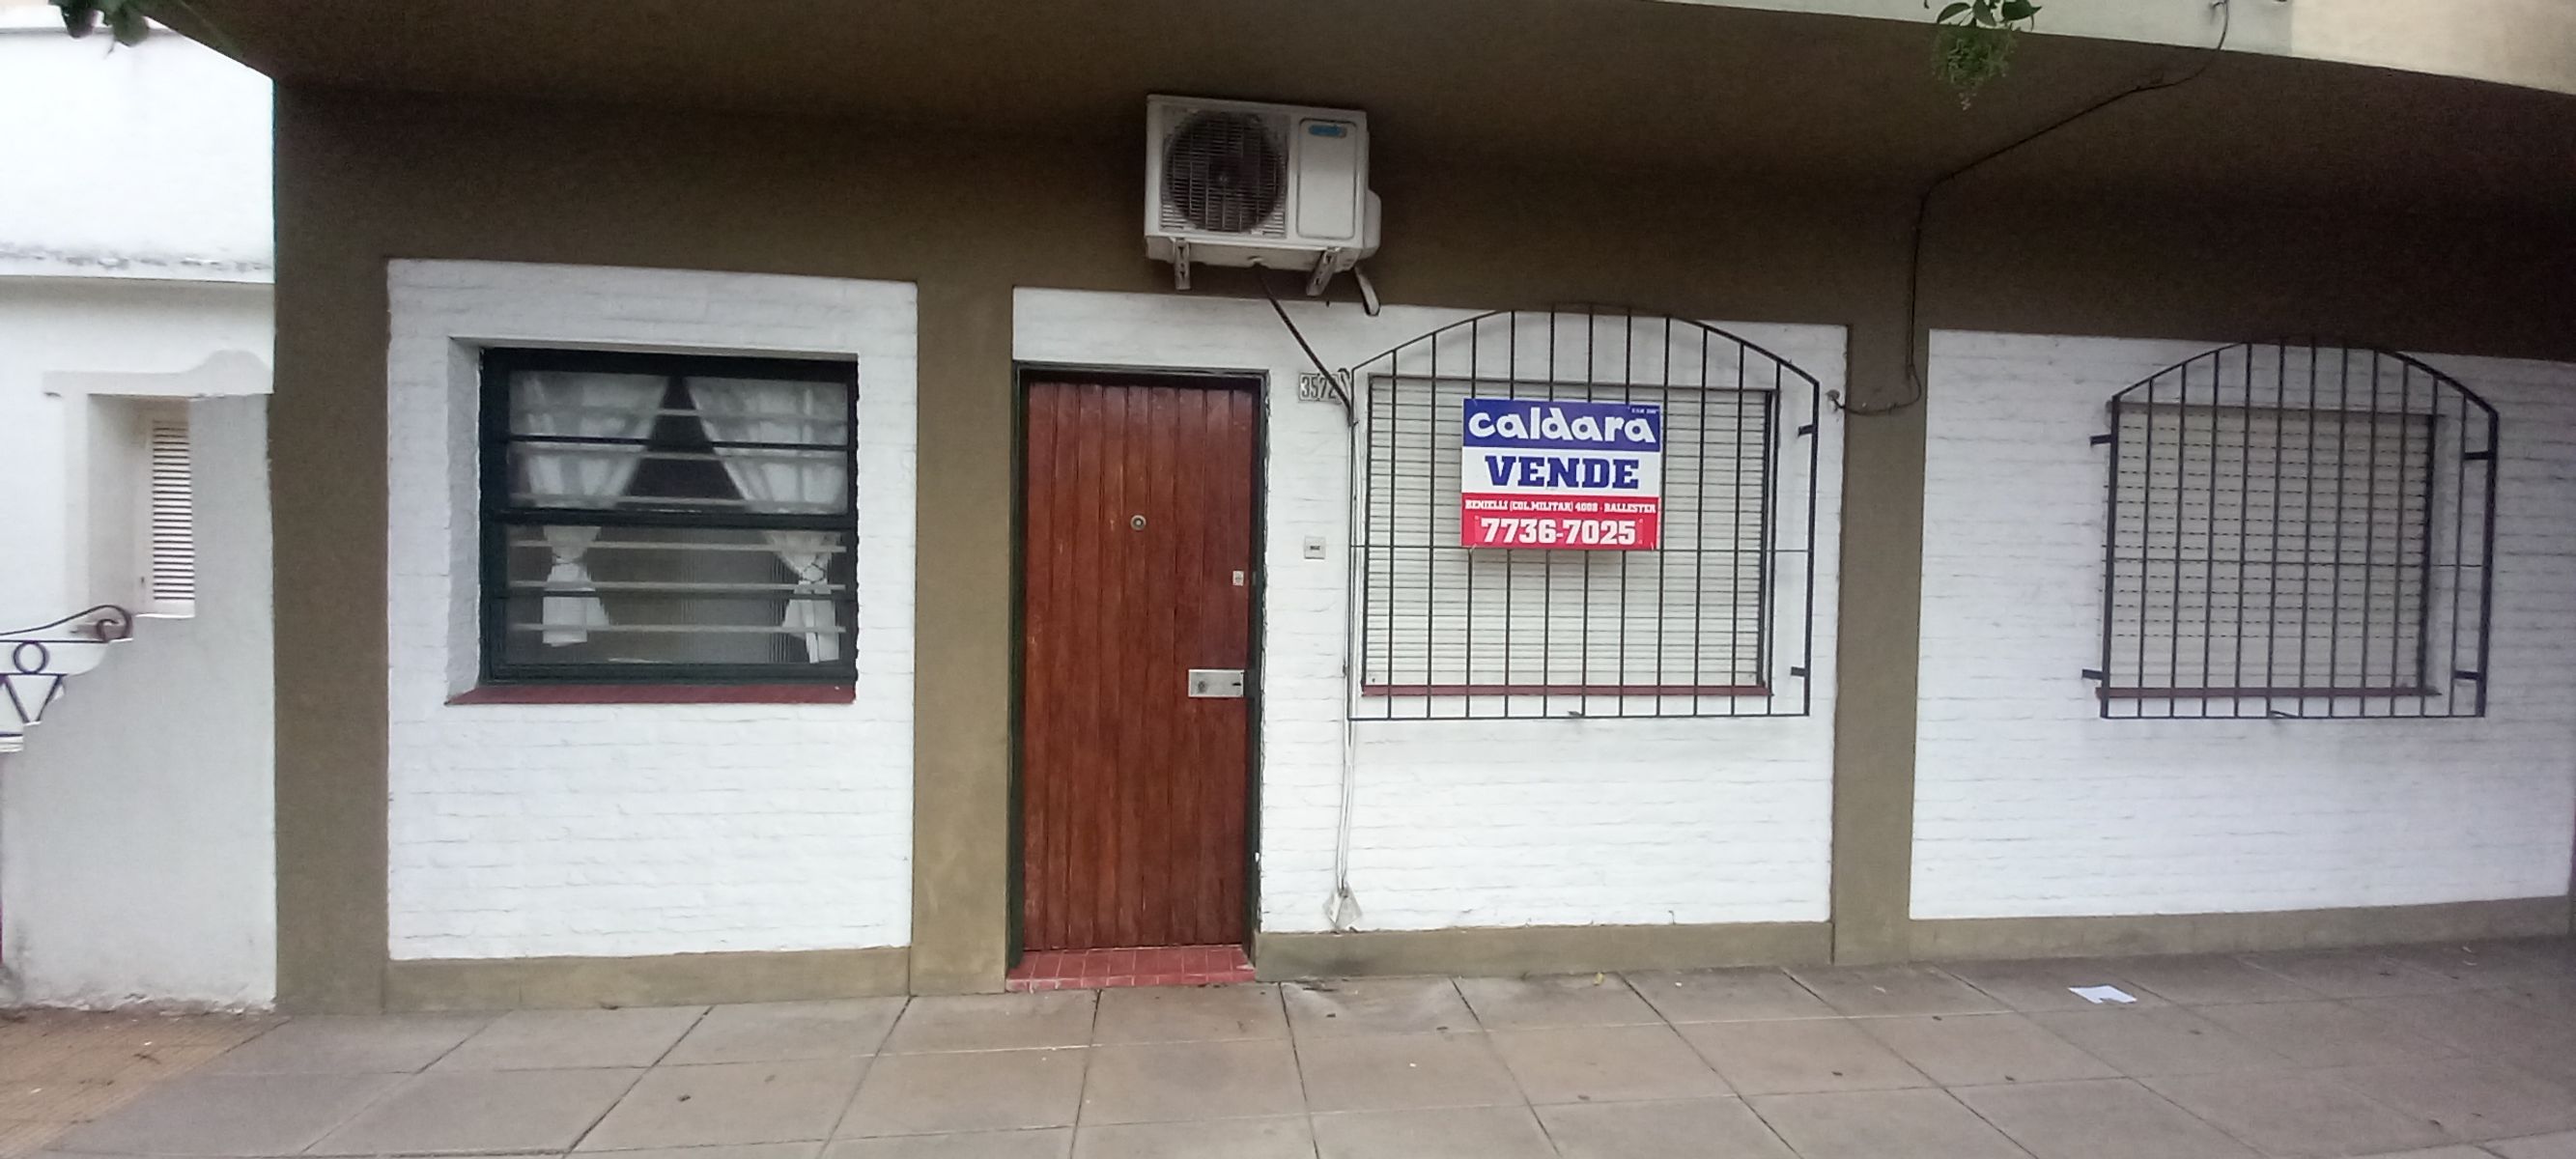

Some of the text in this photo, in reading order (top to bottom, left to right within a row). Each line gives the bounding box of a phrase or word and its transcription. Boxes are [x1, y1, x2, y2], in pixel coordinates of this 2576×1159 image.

[1468, 407, 1656, 443] caldara
[1485, 455, 1640, 490] VENDE
[1603, 502, 1656, 514] BALLESTER
[1481, 518, 1636, 546] 7736-7025
